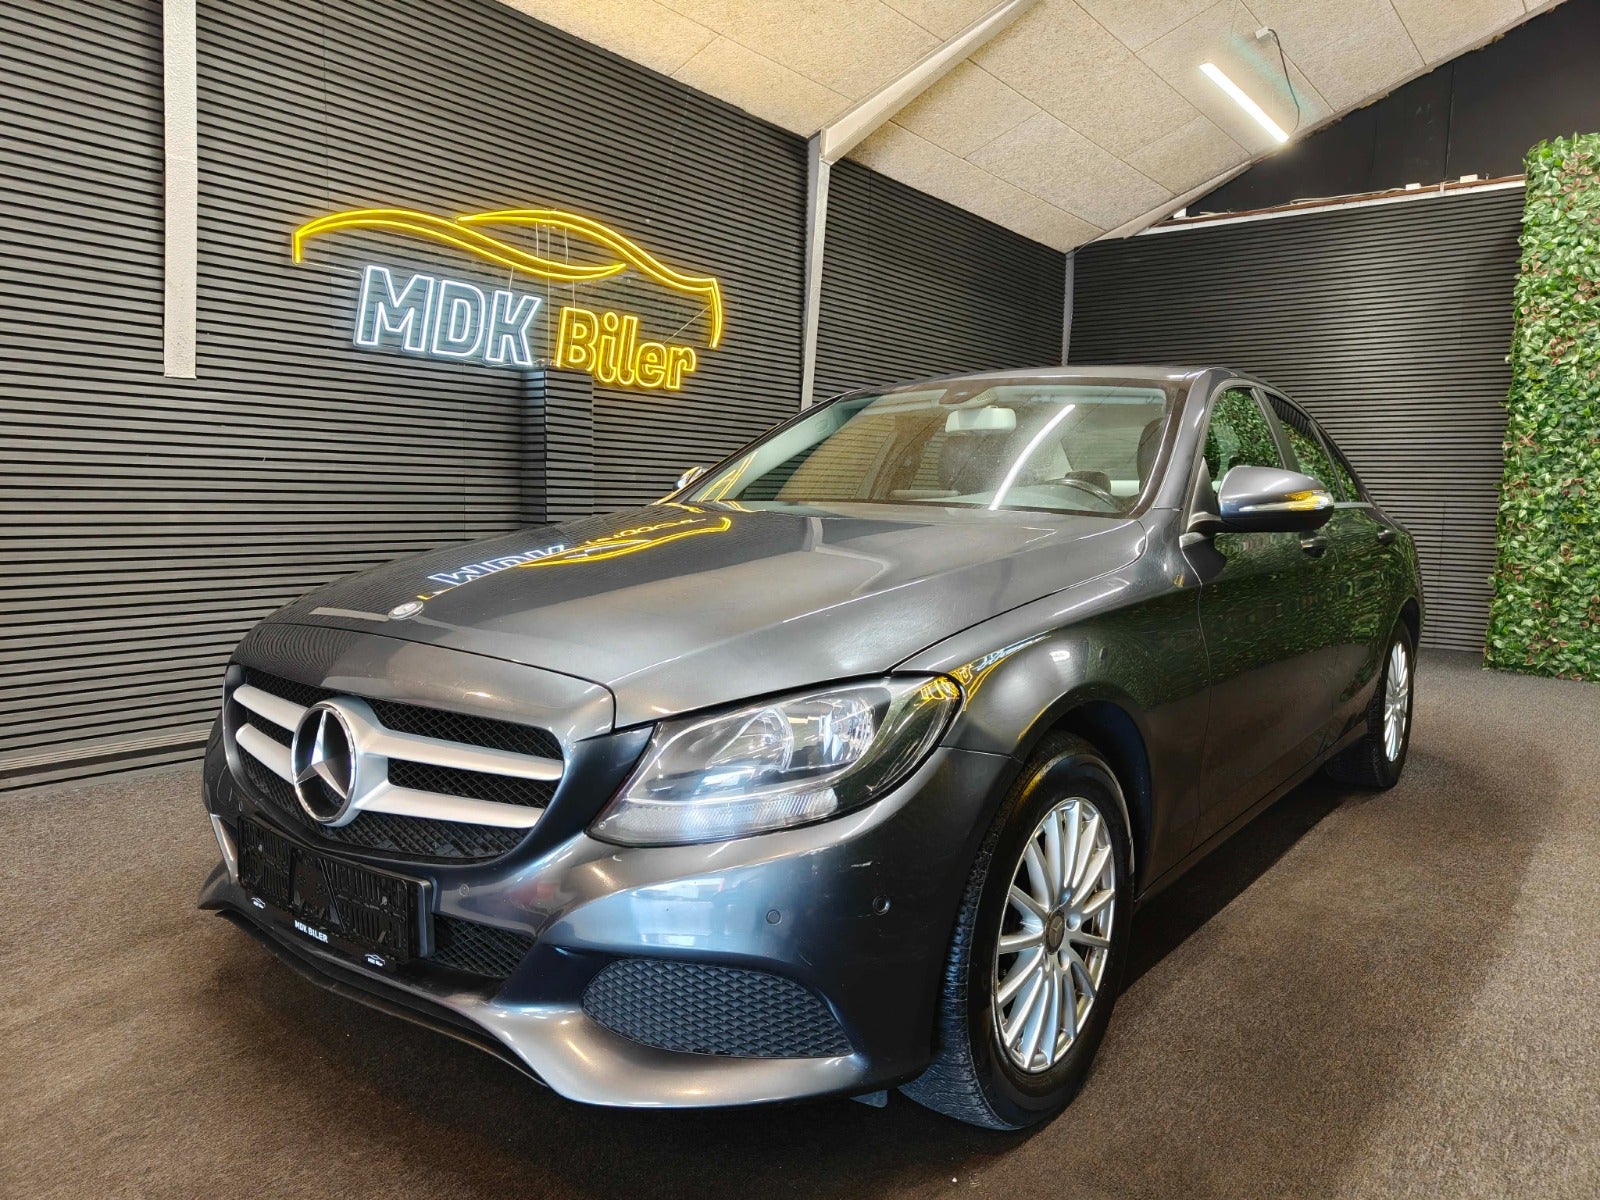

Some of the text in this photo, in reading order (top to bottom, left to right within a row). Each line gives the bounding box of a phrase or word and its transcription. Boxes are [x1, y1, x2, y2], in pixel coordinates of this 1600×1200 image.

[353, 264, 697, 390] MDK Biler
[308, 926, 329, 944] BILER
